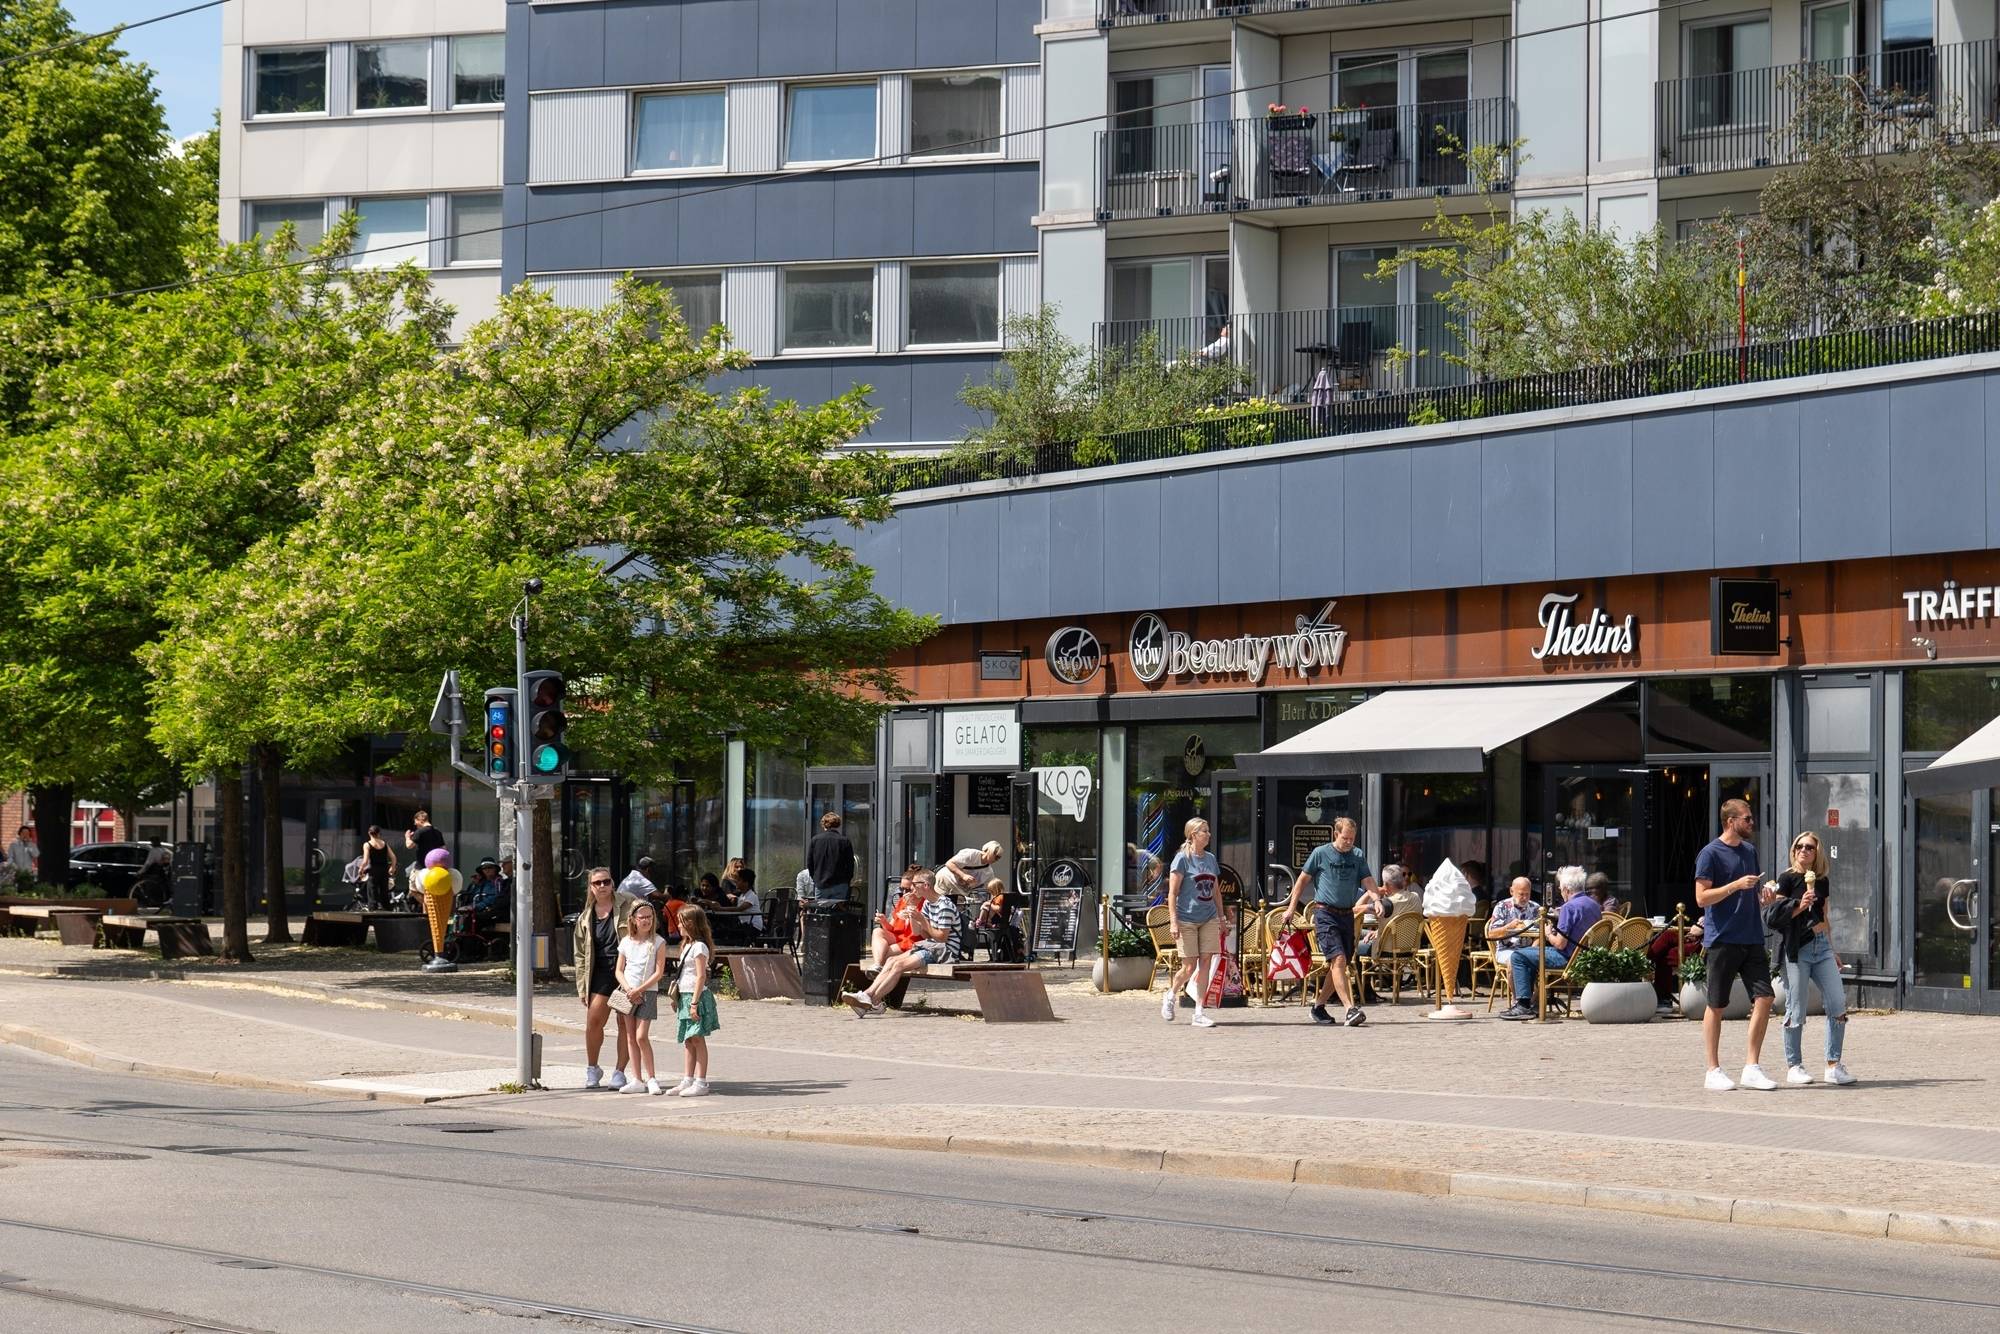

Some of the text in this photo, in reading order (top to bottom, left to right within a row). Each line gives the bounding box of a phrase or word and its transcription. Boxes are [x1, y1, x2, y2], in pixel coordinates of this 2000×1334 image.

[1729, 602, 1771, 623] Thelins
[1532, 593, 1632, 659] Thelins
[984, 658, 1018, 676] SKOG
[1168, 632, 1271, 682] Beauty
[1281, 703, 1305, 720] Herr
[1309, 702, 1318, 719] &
[955, 725, 1007, 744] GELATO
[1043, 770, 1089, 802] KOG
